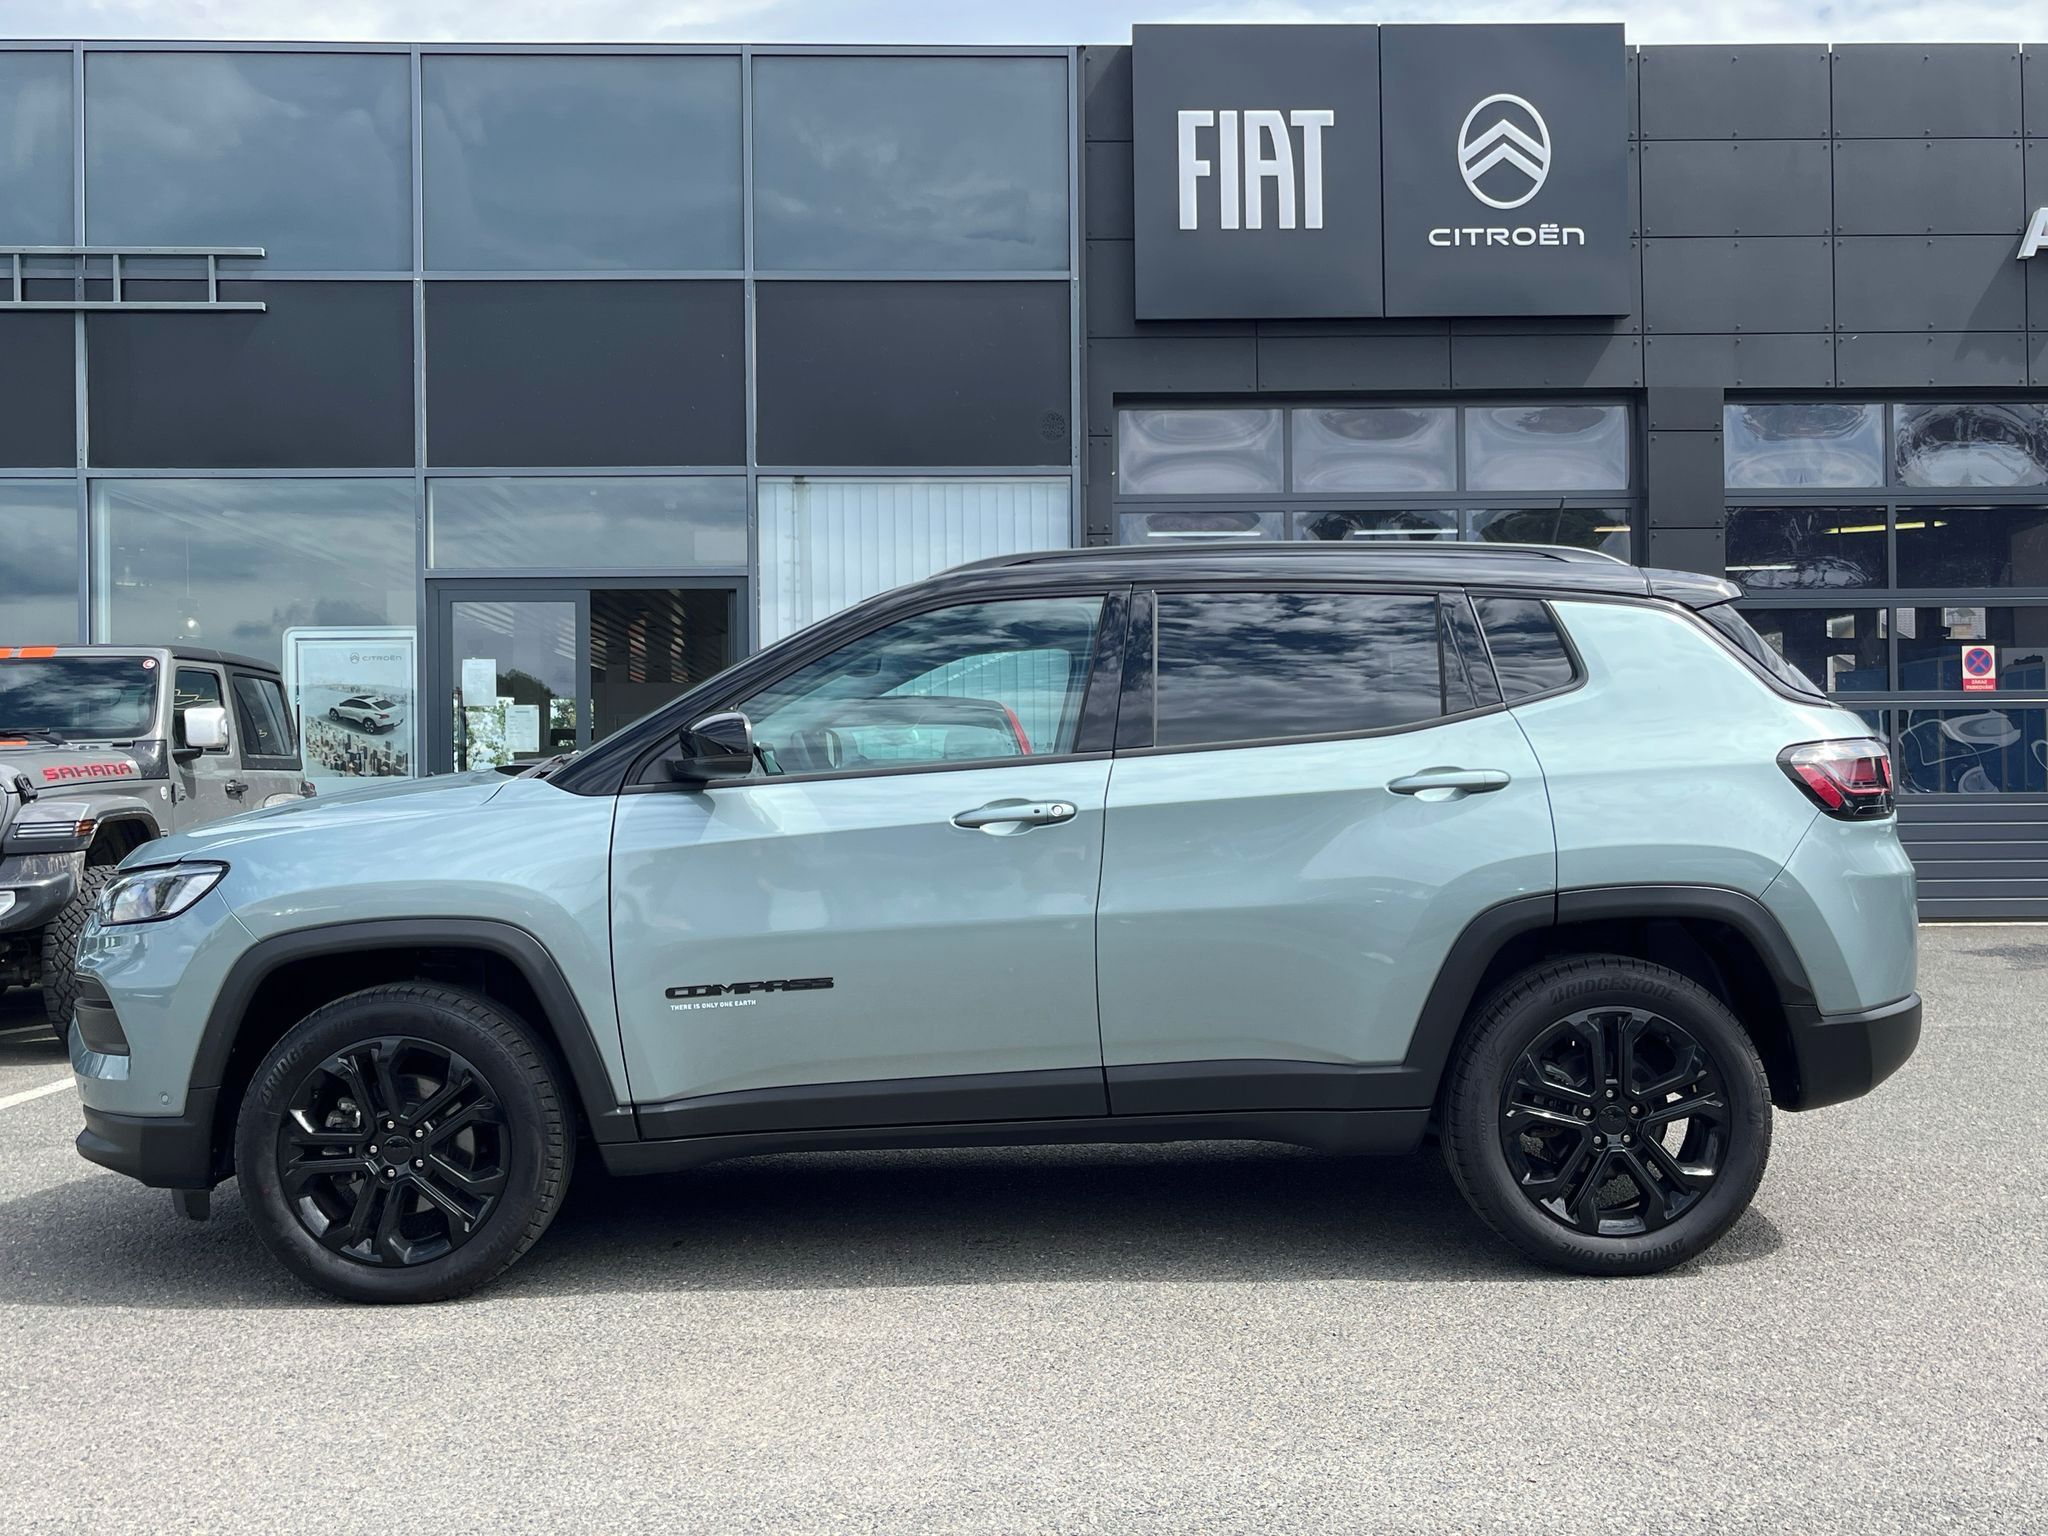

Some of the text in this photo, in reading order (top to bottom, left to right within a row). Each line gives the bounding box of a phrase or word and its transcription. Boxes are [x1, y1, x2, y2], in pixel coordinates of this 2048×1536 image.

[1177, 109, 1335, 230] FIAT
[1427, 223, 1586, 247] CITROËN
[42, 762, 133, 782] SAHARA
[664, 976, 835, 1000] COMPASS
[1549, 976, 1679, 1006] BRIDGESTONE
[670, 1003, 692, 1011] THERE
[701, 1002, 719, 1010] ONLY
